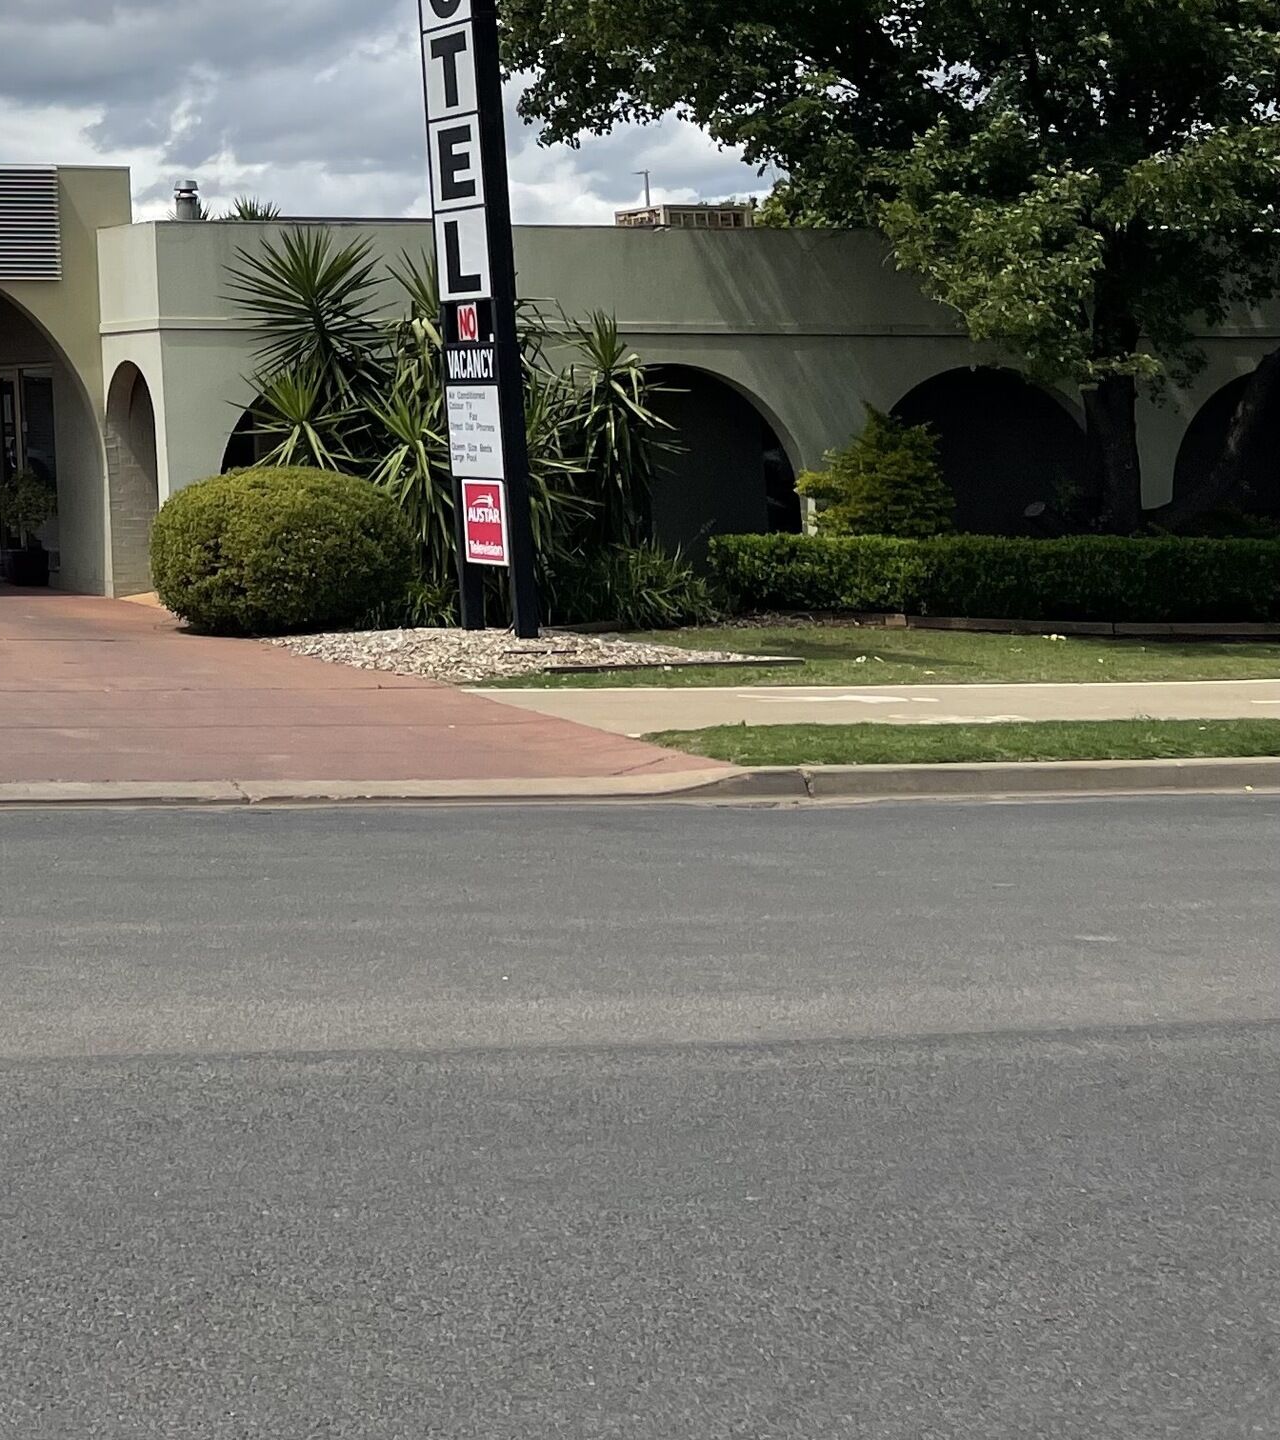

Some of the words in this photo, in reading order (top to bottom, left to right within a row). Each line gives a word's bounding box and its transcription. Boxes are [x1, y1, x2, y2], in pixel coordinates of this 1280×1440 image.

[459, 307, 476, 340] NO
[446, 348, 494, 379] VACANCY
[468, 507, 501, 524] AUSTAR
[469, 540, 504, 557] Television
